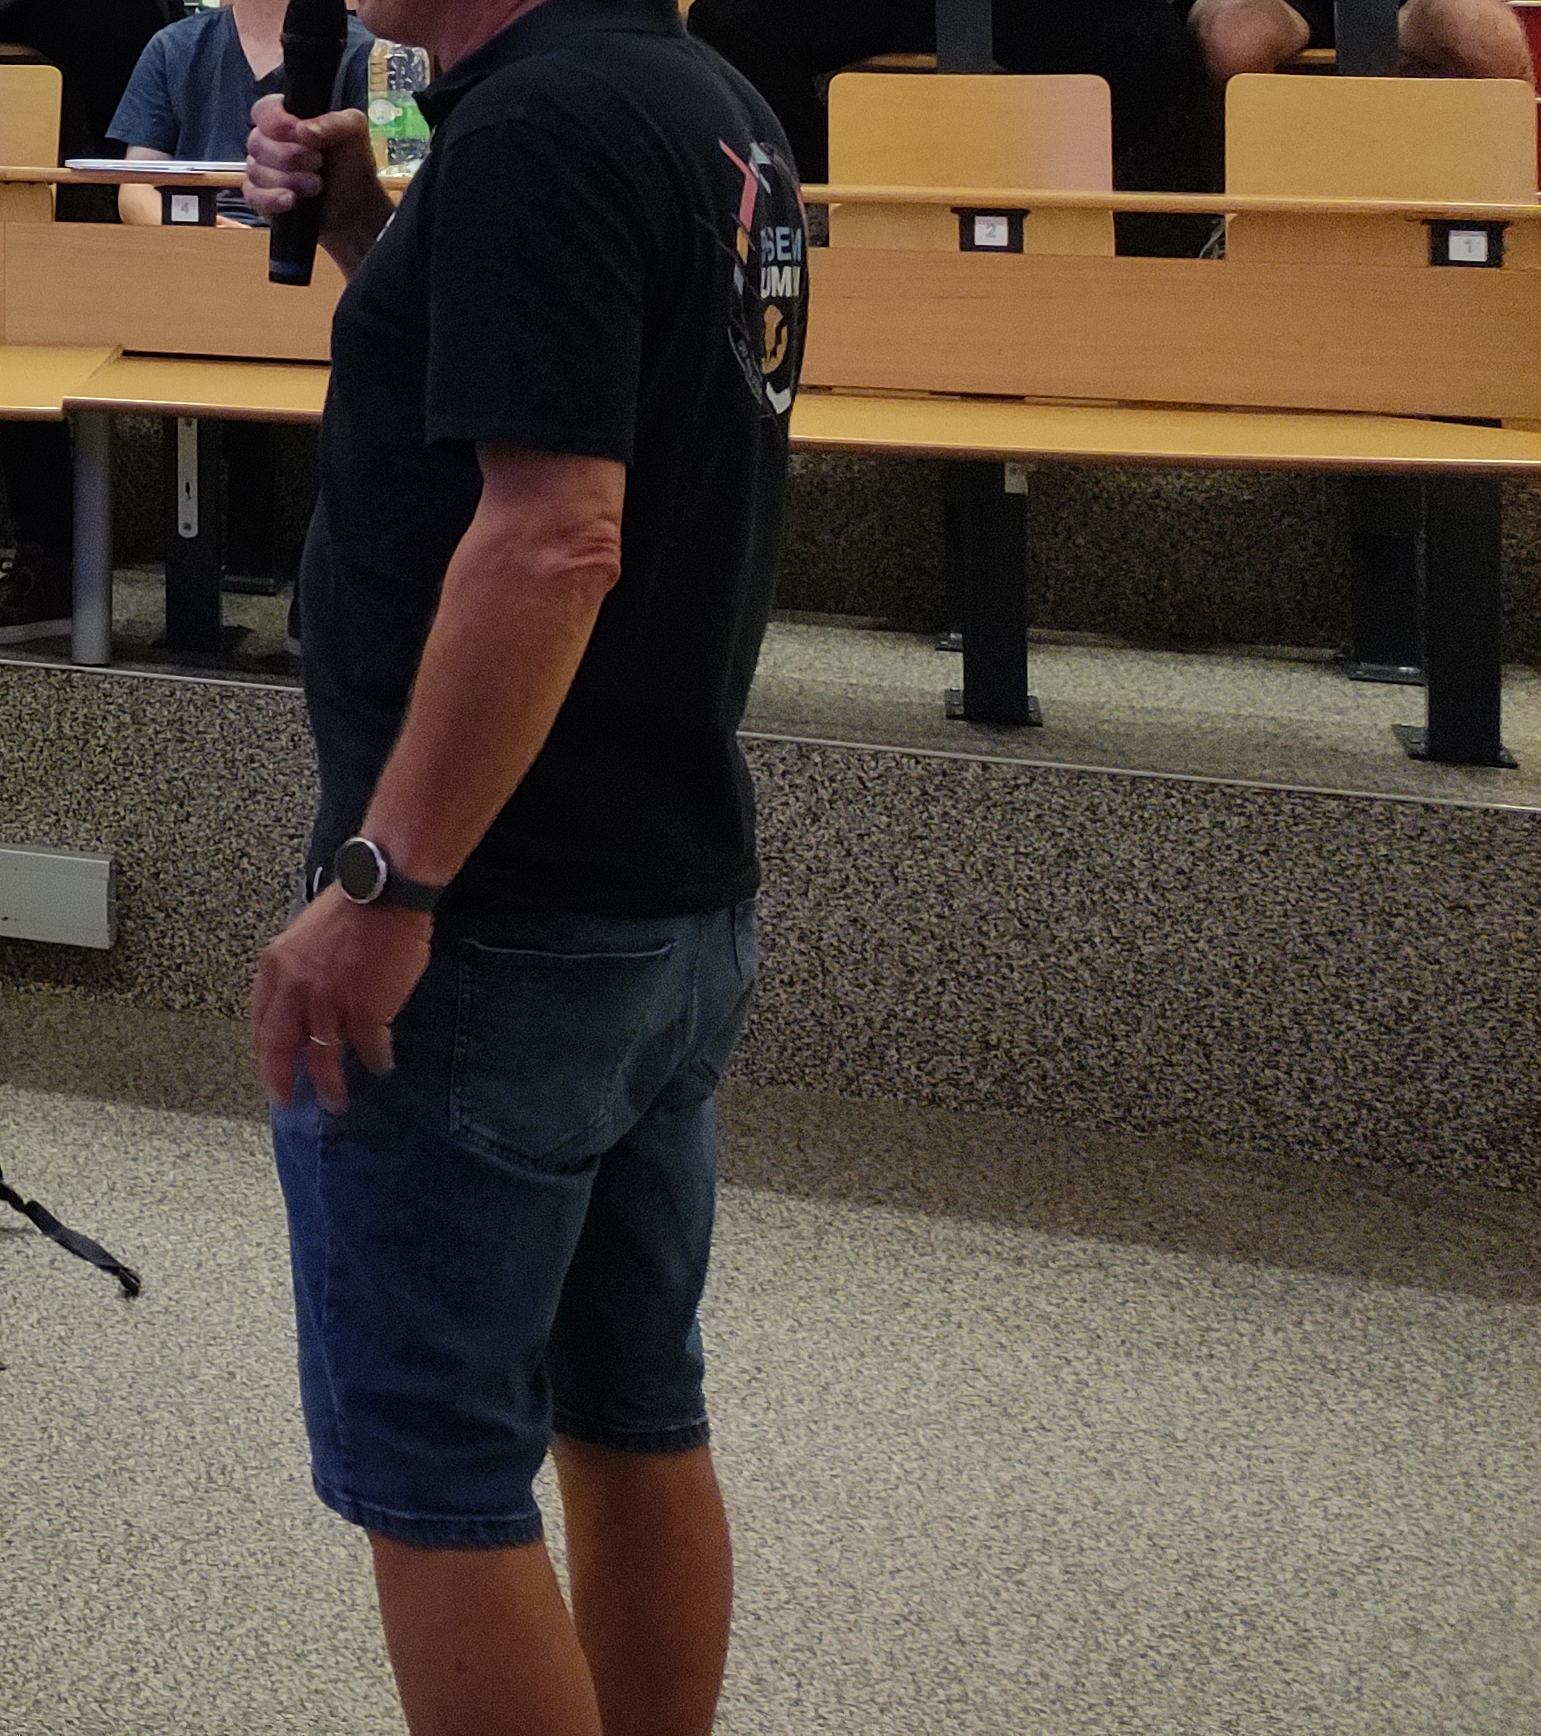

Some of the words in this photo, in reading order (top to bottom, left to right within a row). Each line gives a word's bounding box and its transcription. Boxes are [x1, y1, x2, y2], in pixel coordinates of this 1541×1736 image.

[181, 201, 190, 214] 4
[985, 223, 996, 238] 2
[1463, 239, 1472, 253] 1
